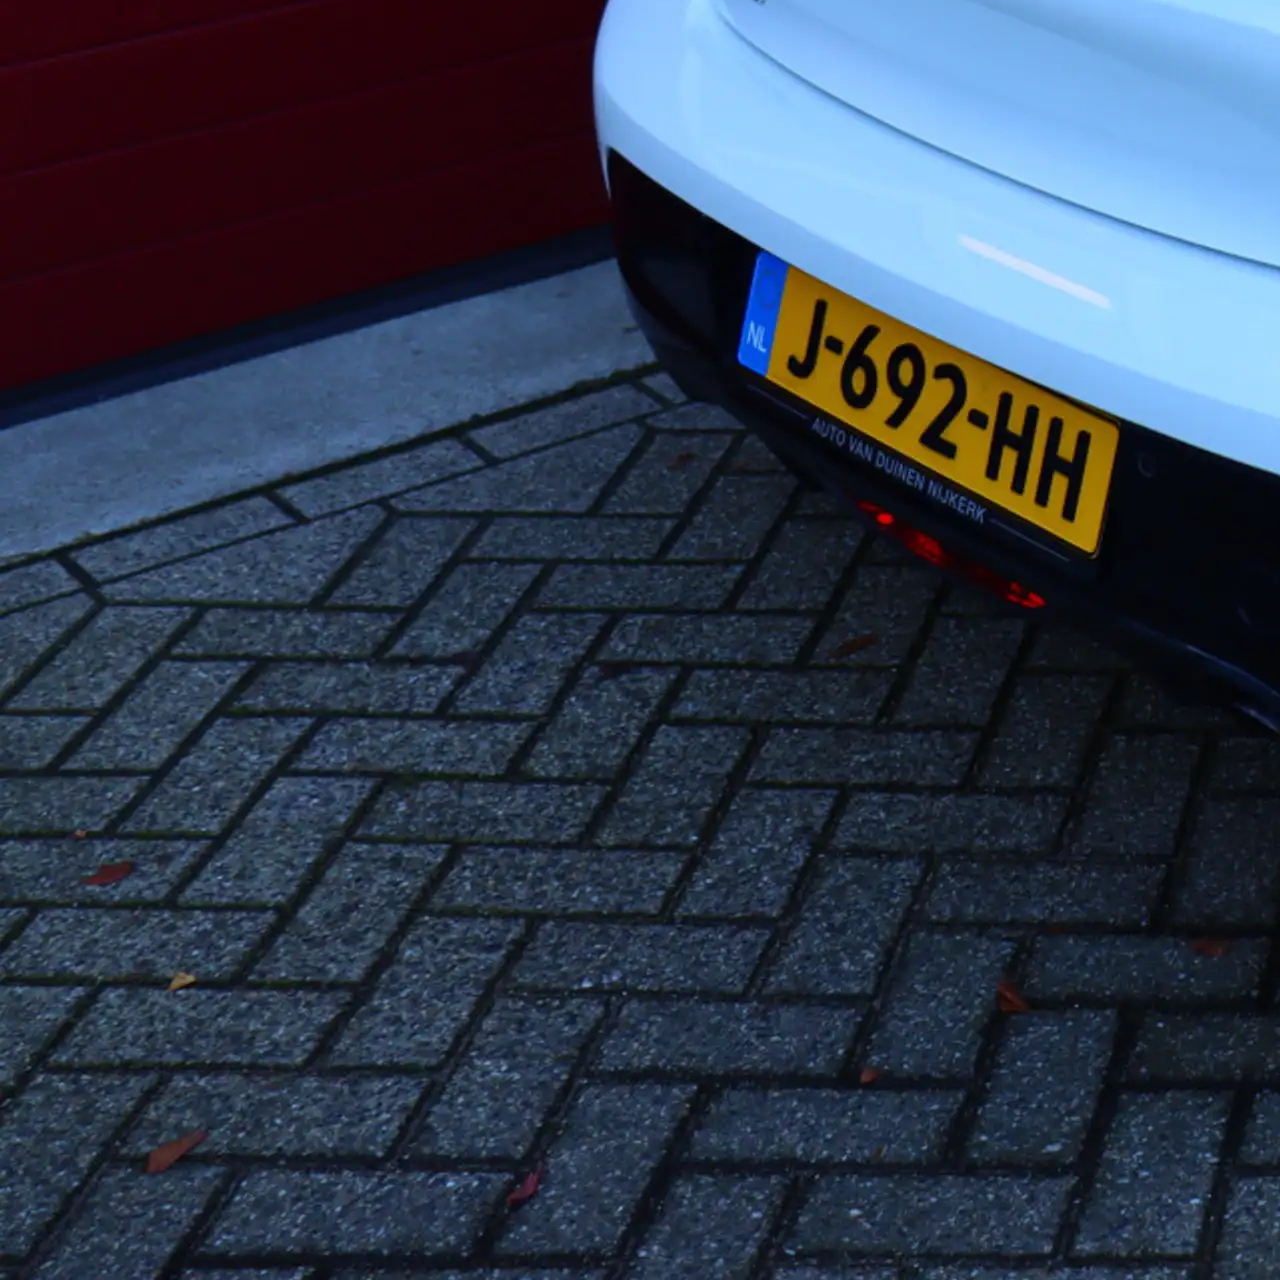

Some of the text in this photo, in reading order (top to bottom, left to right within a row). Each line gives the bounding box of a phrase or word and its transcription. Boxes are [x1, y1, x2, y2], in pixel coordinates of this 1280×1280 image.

[747, 322, 768, 353] NL
[786, 298, 1092, 524] J-692-HH
[812, 417, 988, 524] AUTO VAN DUINEN NIJKERK
